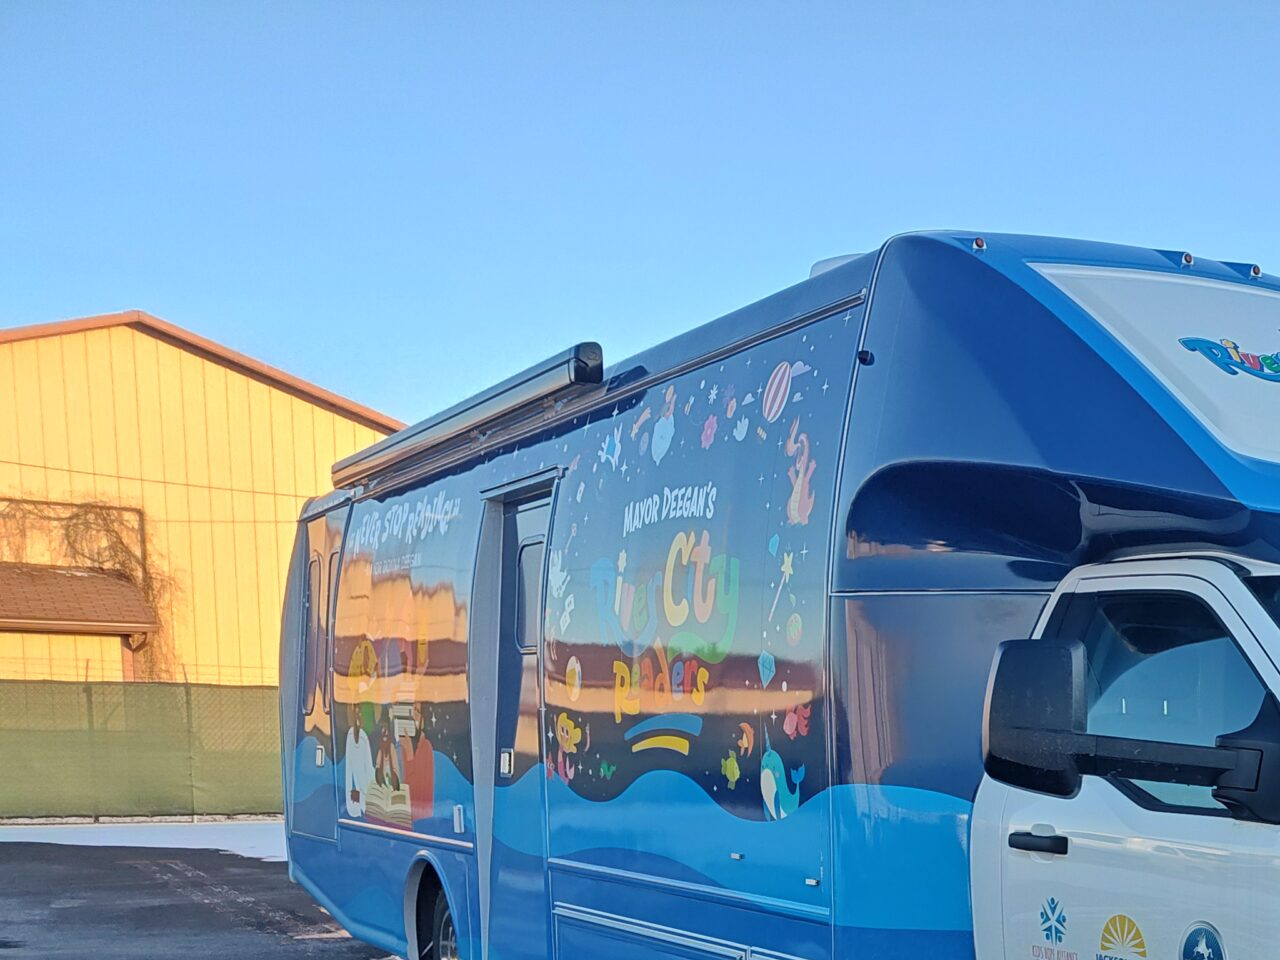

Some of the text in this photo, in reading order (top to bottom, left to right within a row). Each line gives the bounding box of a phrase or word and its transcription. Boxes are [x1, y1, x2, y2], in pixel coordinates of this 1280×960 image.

[381, 502, 410, 543] STOP
[622, 480, 717, 537] MAYOR DEEGAN'S
[590, 549, 662, 658] River
[612, 636, 710, 724] Readers
